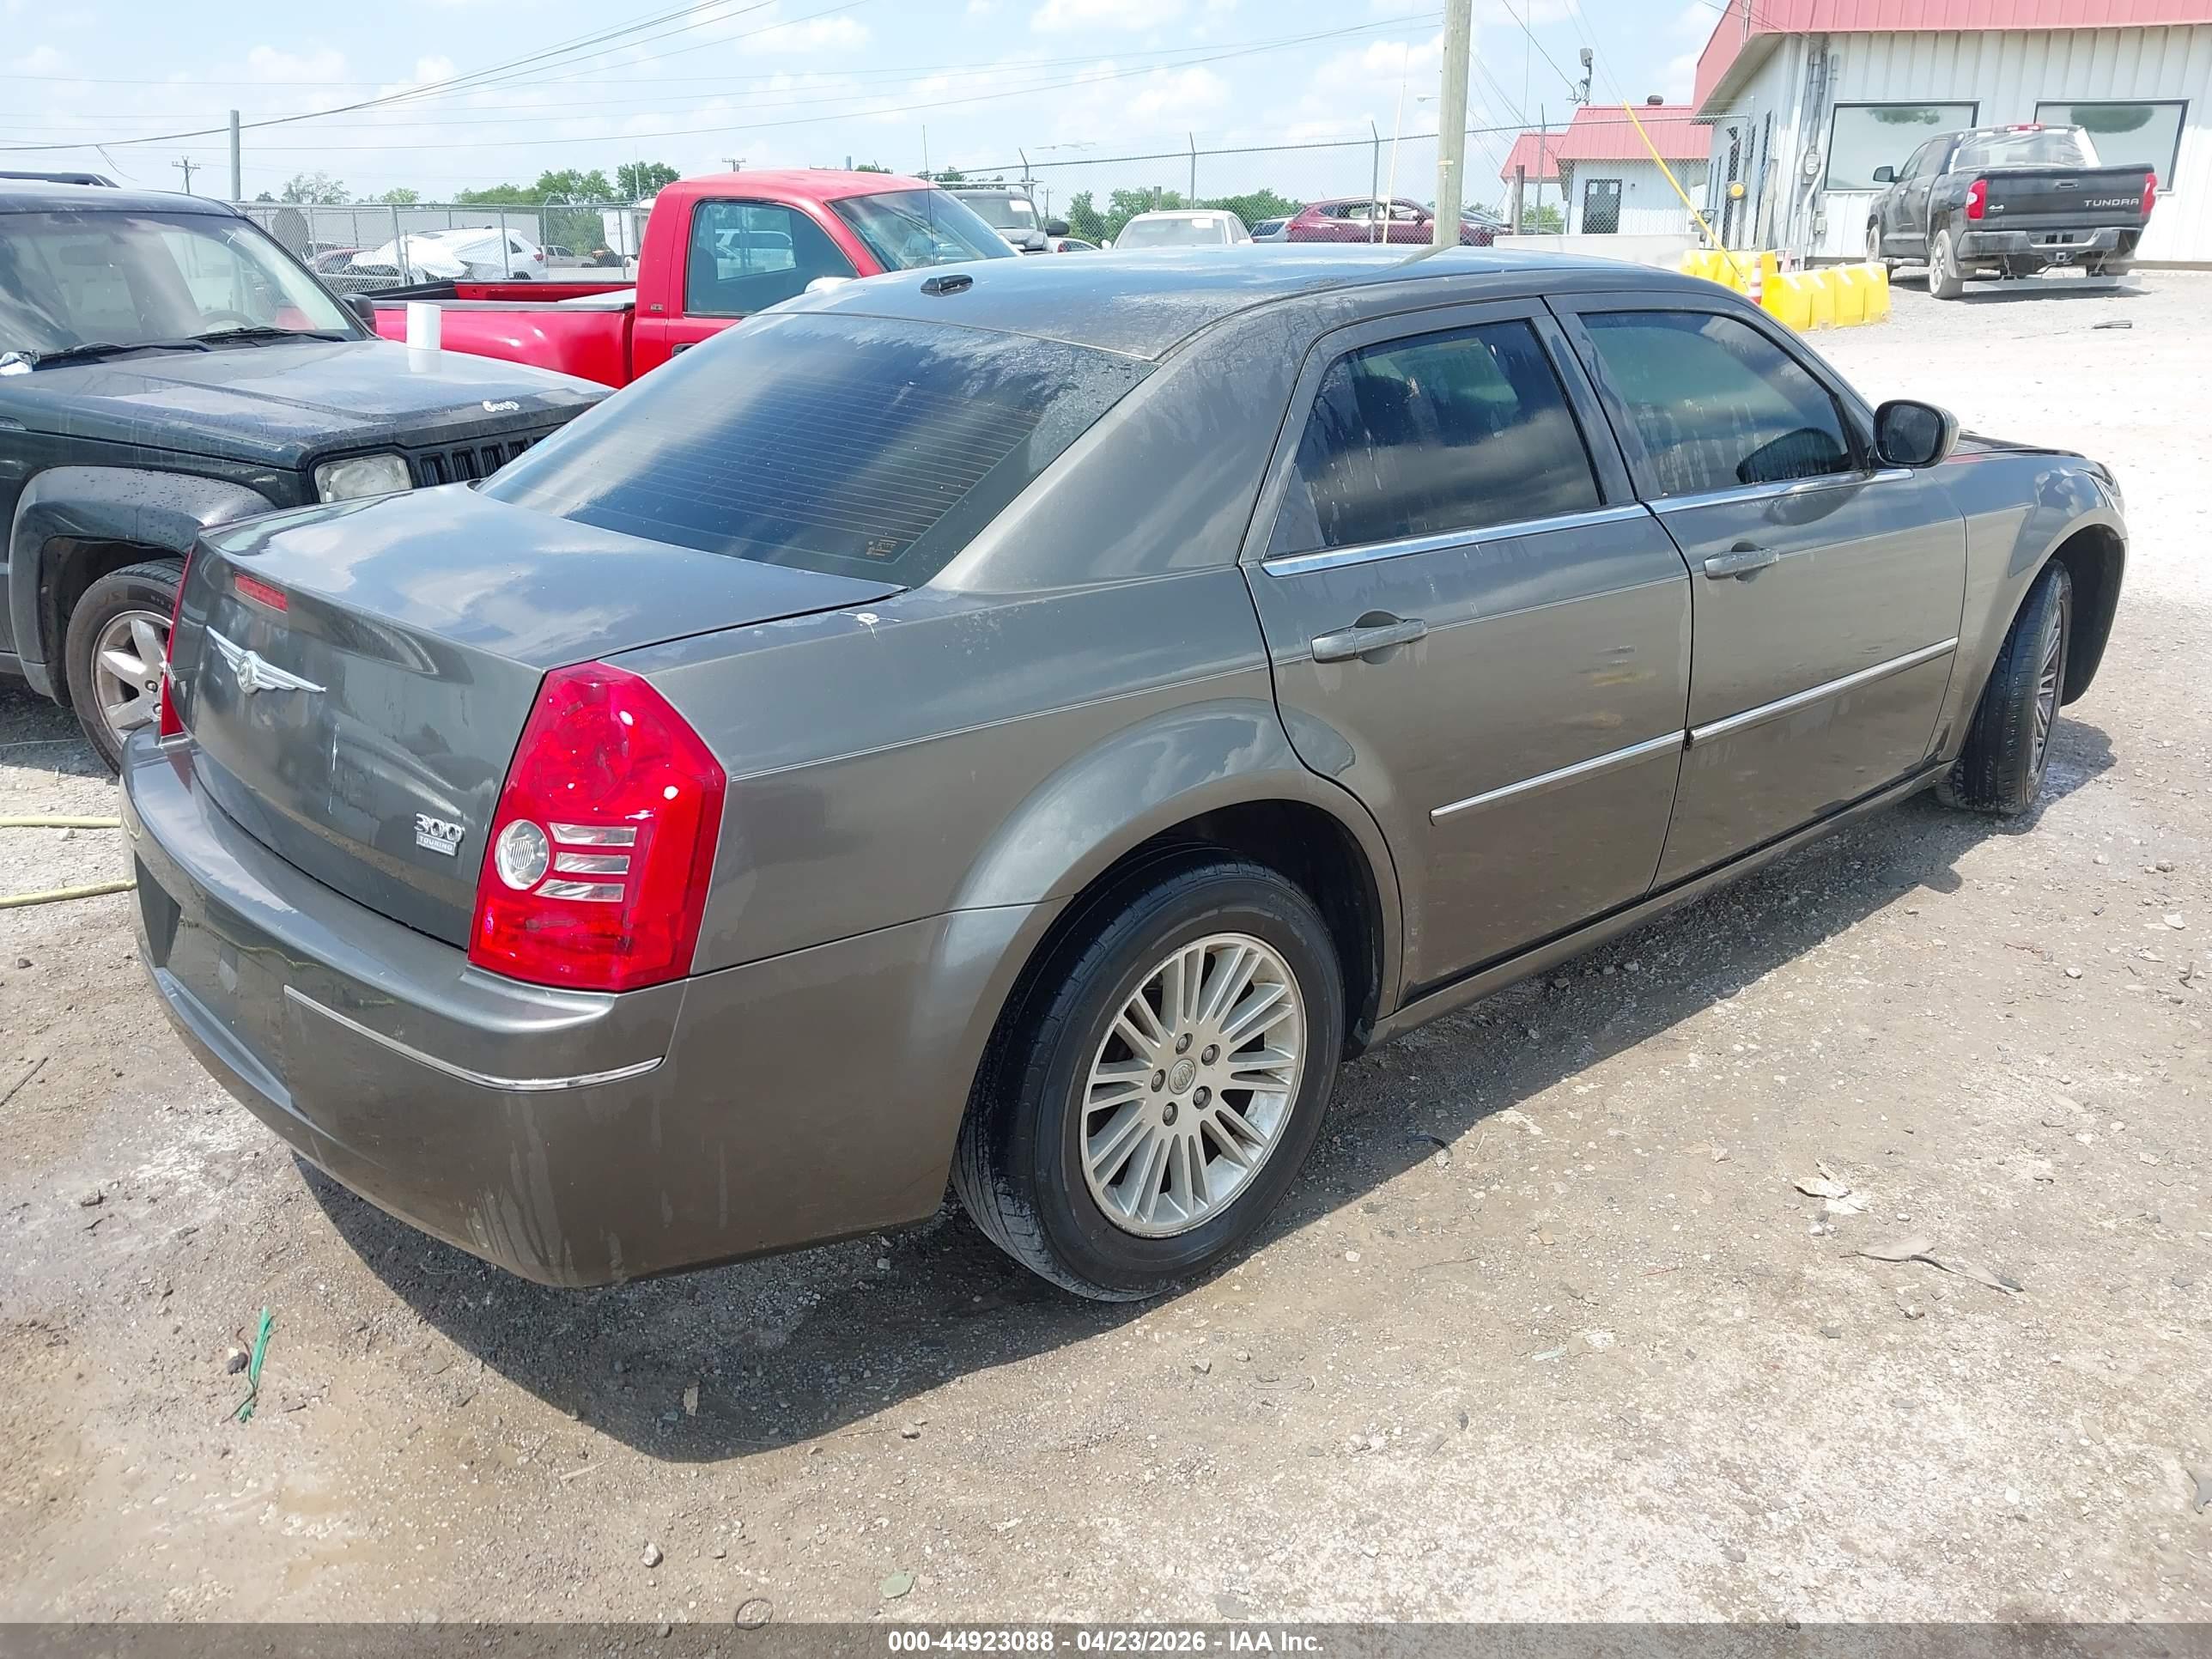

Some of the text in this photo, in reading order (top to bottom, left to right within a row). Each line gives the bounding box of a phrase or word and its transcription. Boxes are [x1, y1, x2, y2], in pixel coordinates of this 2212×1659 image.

[2083, 198, 2140, 207] TUNDRA
[483, 400, 520, 413] Jeep
[414, 813, 463, 843] 300
[419, 835, 453, 851] TOURING
